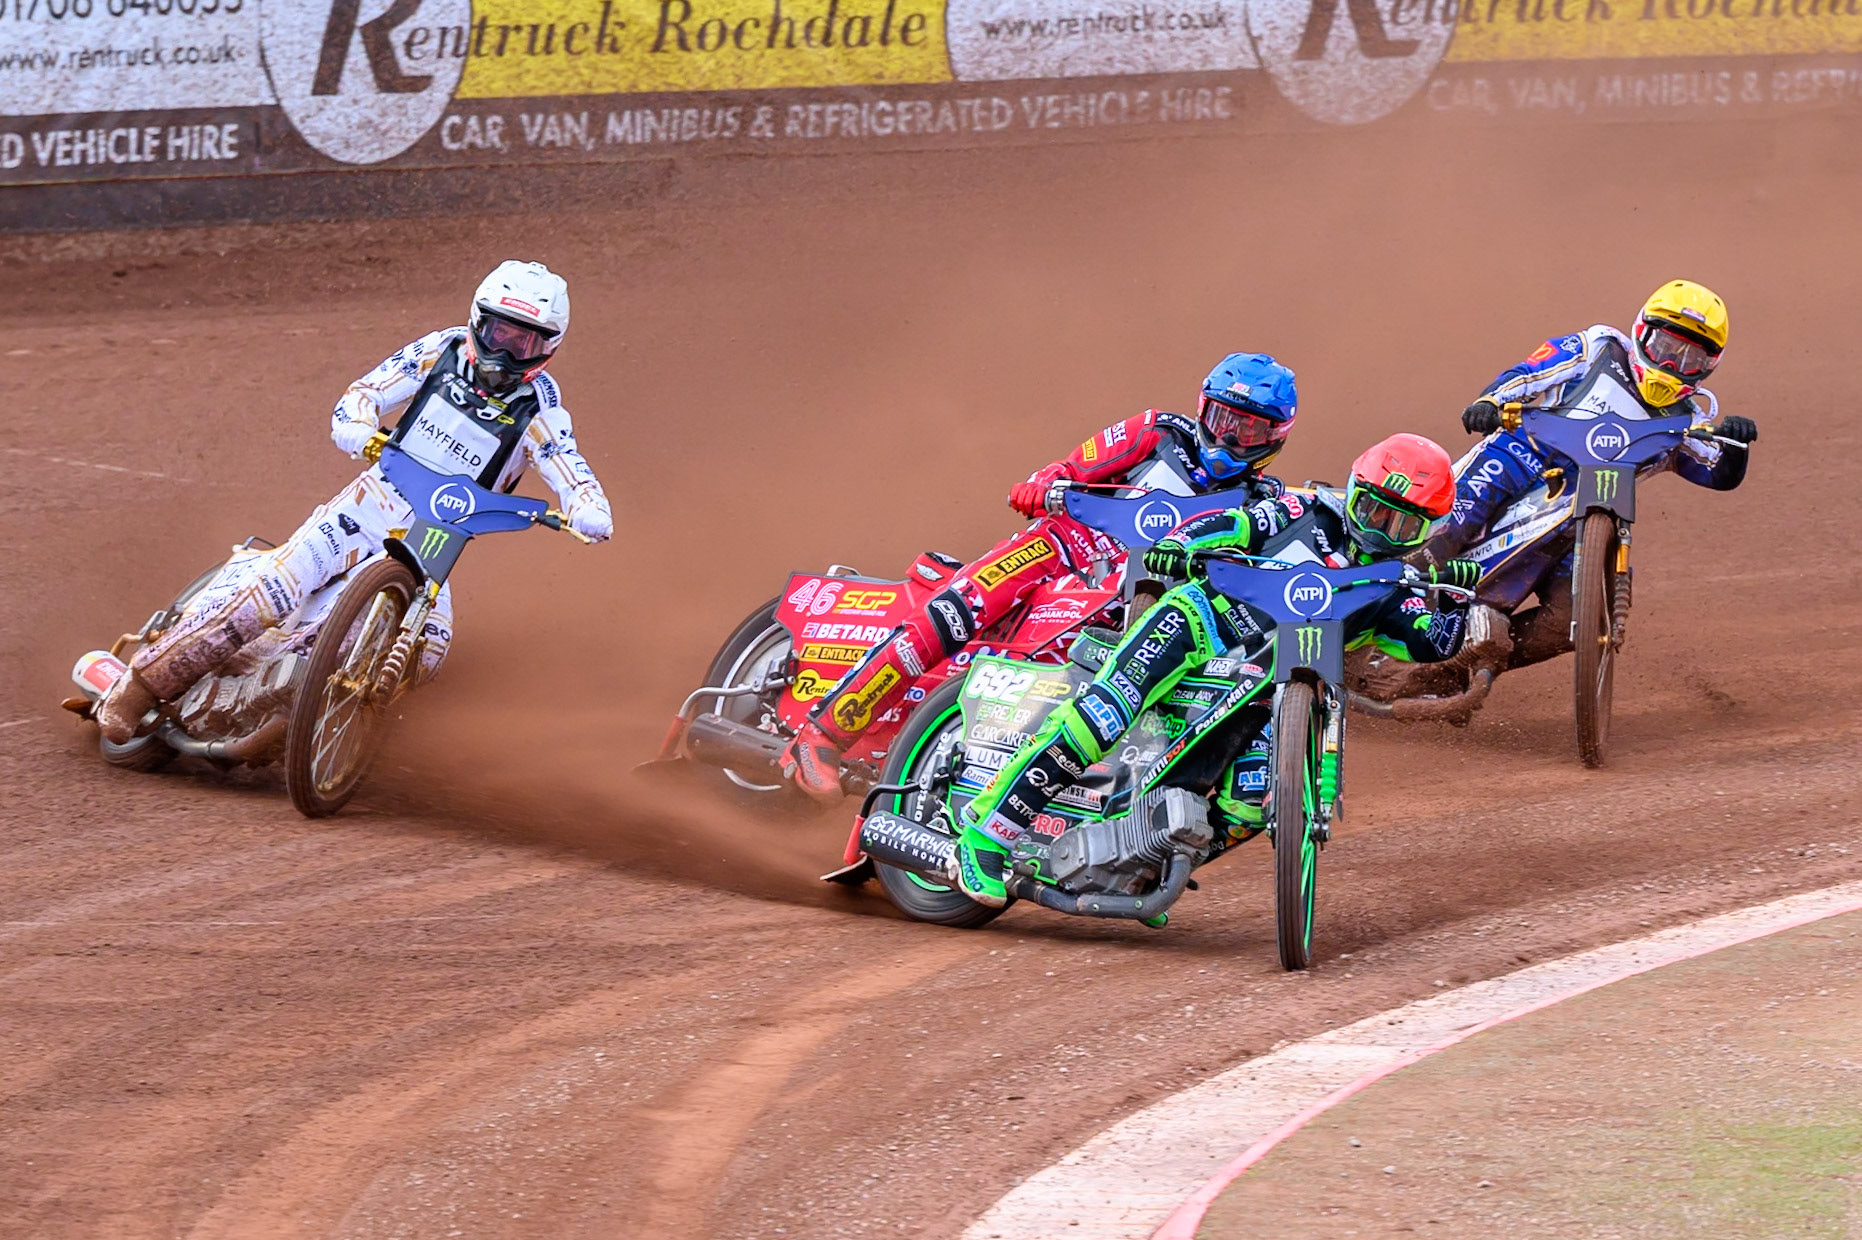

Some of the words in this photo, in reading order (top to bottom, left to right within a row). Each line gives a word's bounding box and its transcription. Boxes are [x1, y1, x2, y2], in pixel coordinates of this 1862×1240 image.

[311, 0, 626, 97] Rentruck
[650, 0, 927, 53] Rochdale
[441, 114, 511, 153] CAR,
[520, 111, 594, 151] VAN,
[604, 106, 741, 145] MINIBUS
[750, 105, 775, 139] &
[785, 96, 1014, 139] REFRIGERATED
[1021, 91, 1149, 128] VEHICLE
[1160, 86, 1232, 121] HIRE
[30, 127, 160, 168] VEHICLE
[167, 124, 239, 162] HIRE
[416, 416, 482, 467] MAYFIELD
[1593, 435, 1621, 448] ATPI
[1467, 459, 1504, 498] AVO
[437, 493, 467, 513] ATPI
[1142, 514, 1171, 528] ATPI
[318, 522, 341, 556] Neolit
[1312, 526, 1333, 552] FIM
[788, 578, 844, 616] 46
[837, 590, 897, 609] SGP
[1292, 586, 1323, 601] ATPI
[817, 623, 891, 643] BETARD
[1134, 611, 1186, 666] REXER
[967, 663, 1037, 705] 692
[1030, 680, 1071, 697] SGP
[990, 704, 1031, 724] REXER
[1195, 706, 1226, 735] Porta
[1227, 678, 1255, 708] Mare
[863, 828, 906, 852] MOBILE
[912, 847, 944, 869] HOME
